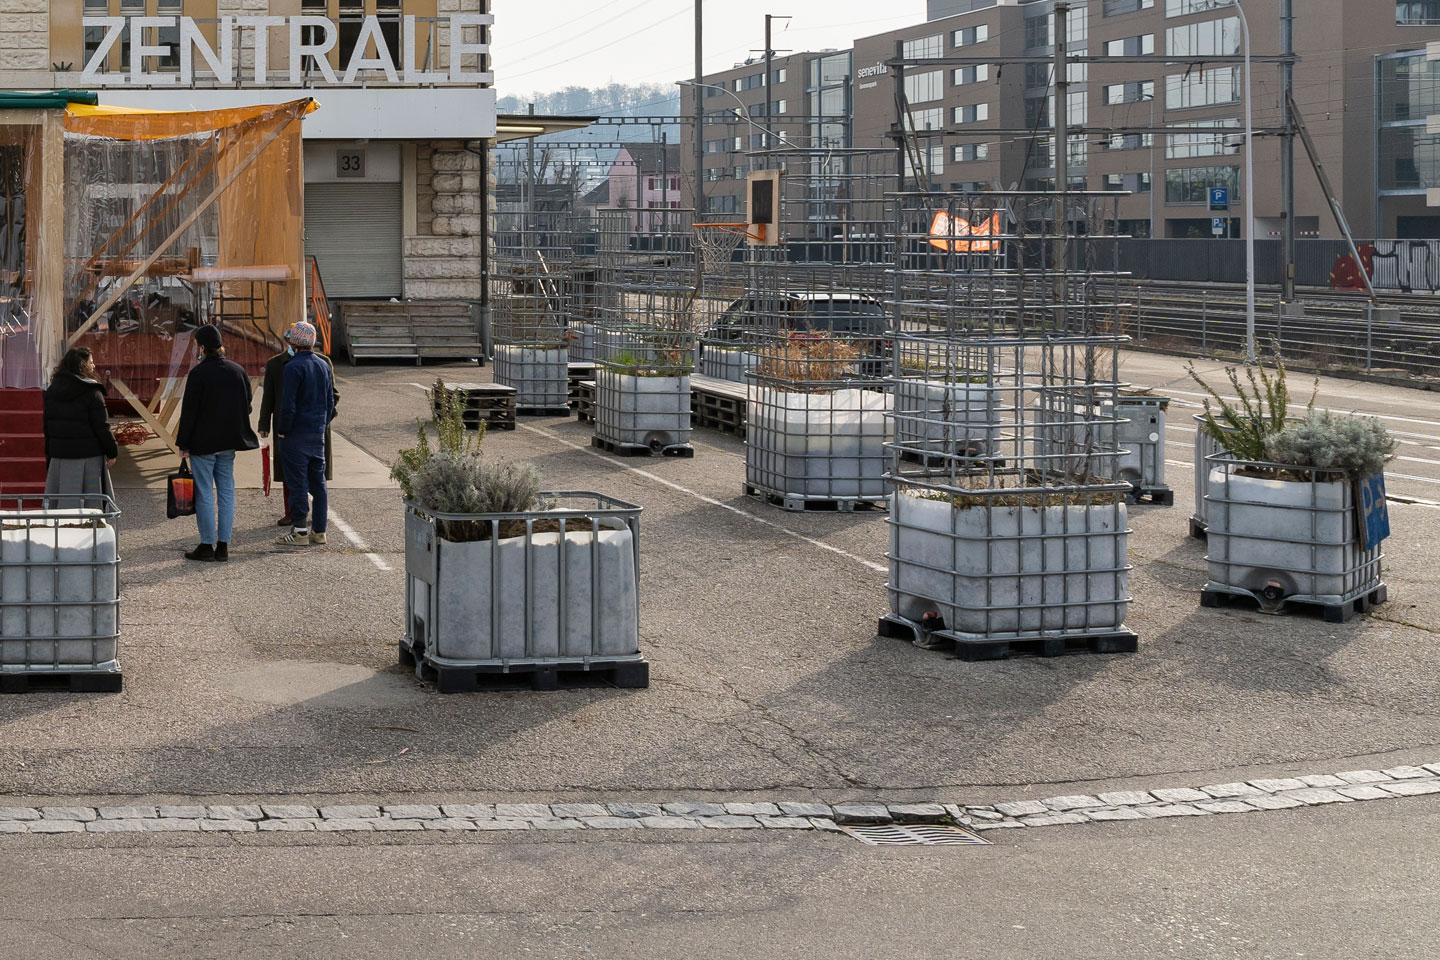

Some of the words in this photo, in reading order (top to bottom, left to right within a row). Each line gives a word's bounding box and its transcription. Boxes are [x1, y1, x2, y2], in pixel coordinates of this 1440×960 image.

[80, 13, 495, 85] ZENTRALE
[341, 155, 361, 171] 33
[1215, 192, 1222, 200] P
[1213, 219, 1220, 227] P
